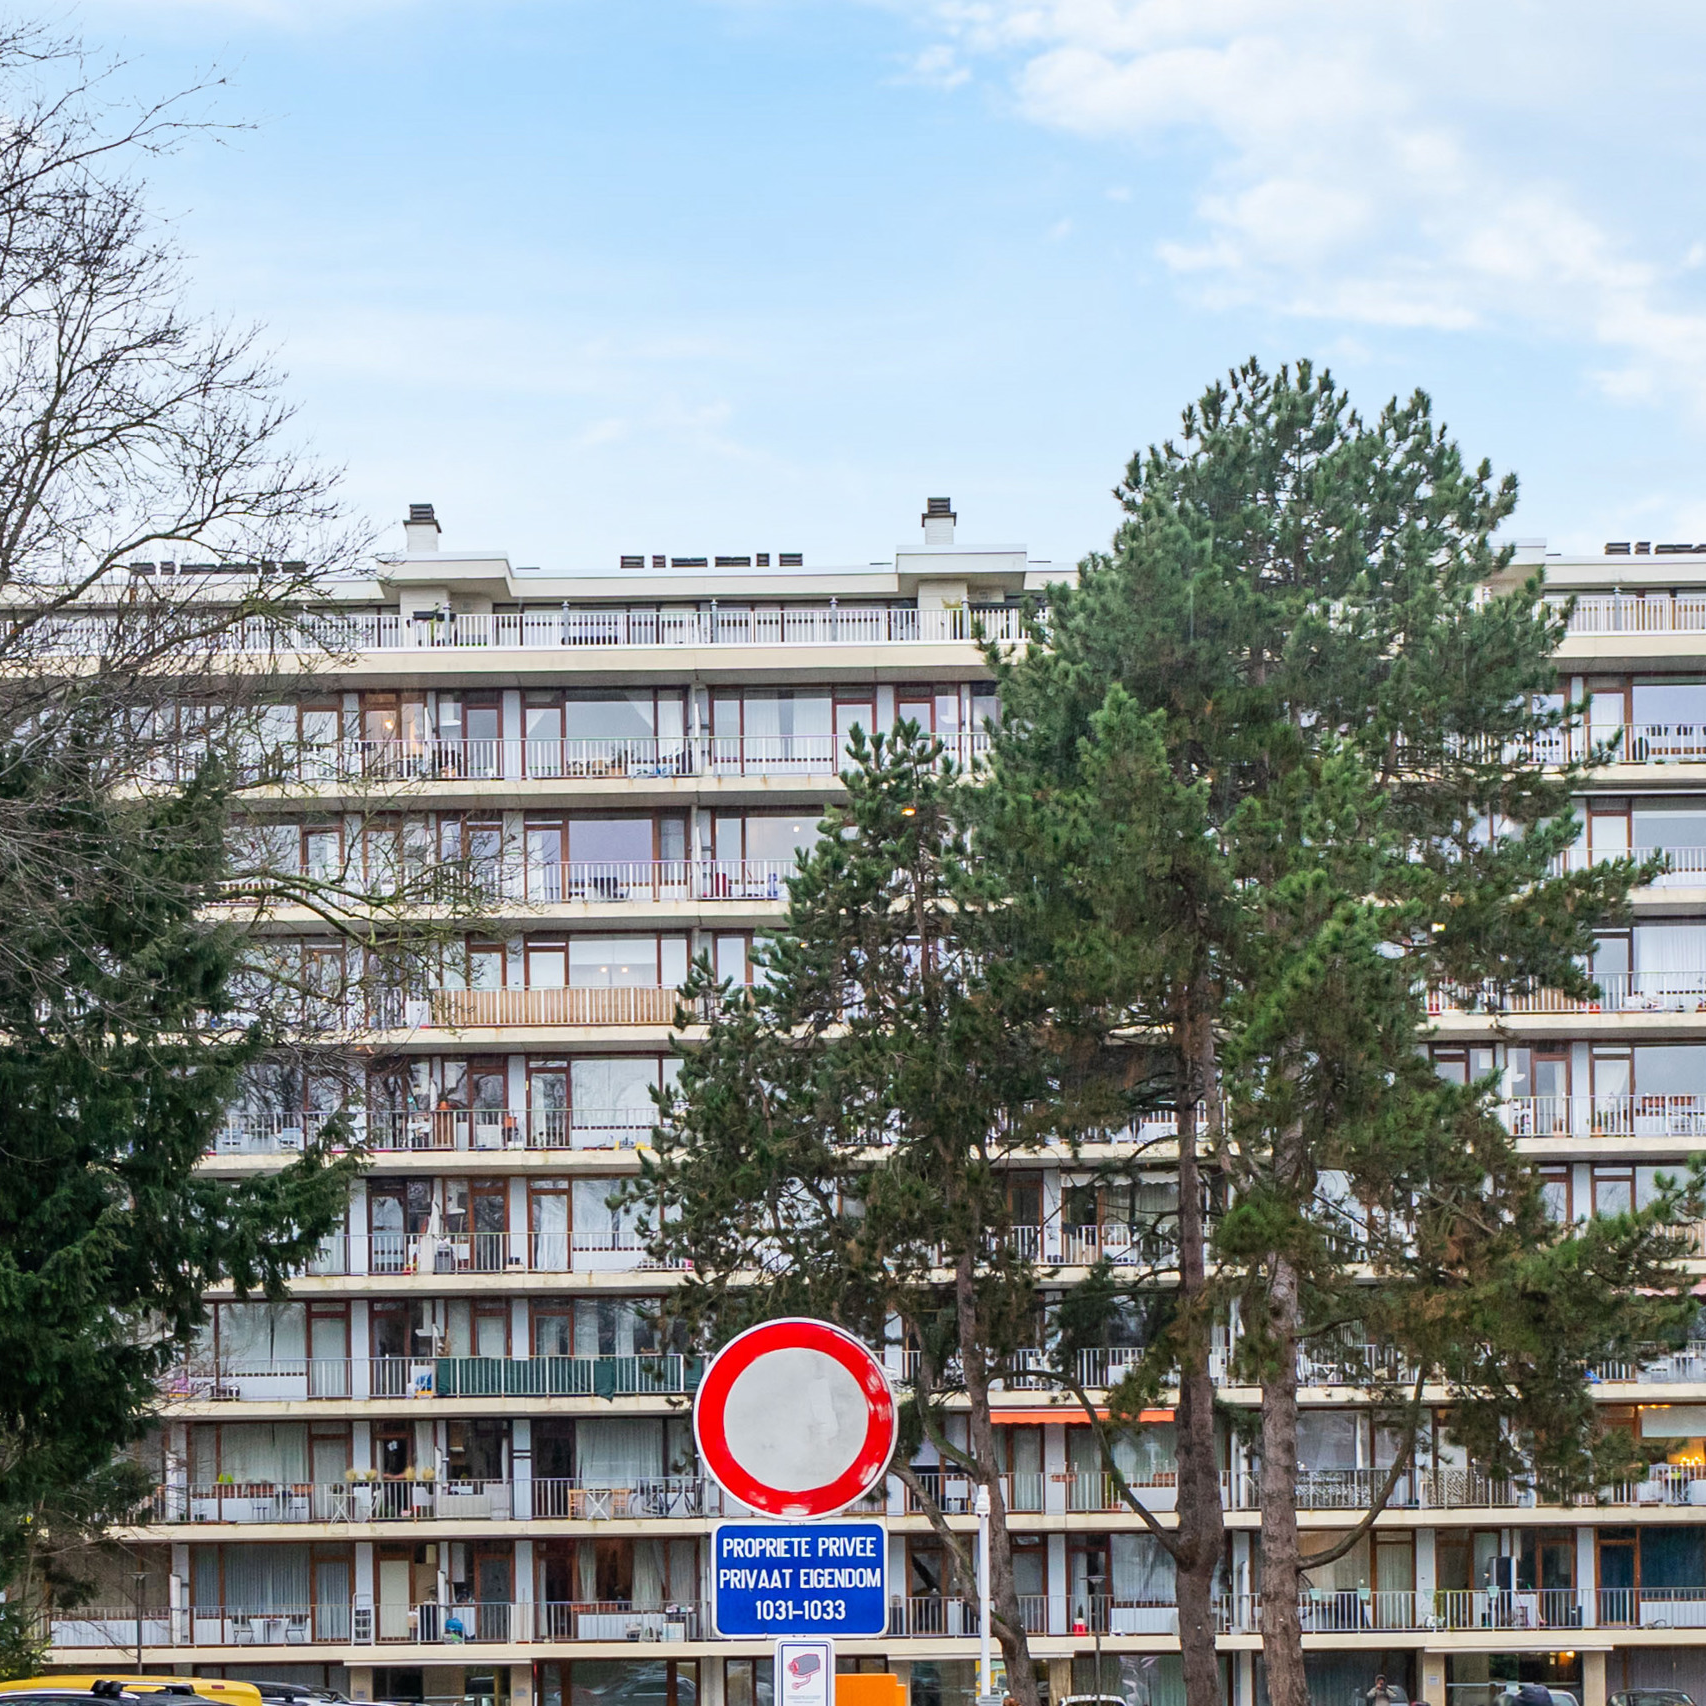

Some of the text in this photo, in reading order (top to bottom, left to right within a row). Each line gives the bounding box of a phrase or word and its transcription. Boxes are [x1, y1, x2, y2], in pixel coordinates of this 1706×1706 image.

[722, 1537, 877, 1557] PROPRIETE PRIVEE
[719, 1568, 881, 1589] PRIVAAT EIGENDOM
[755, 1599, 846, 1620] 1031-1033
